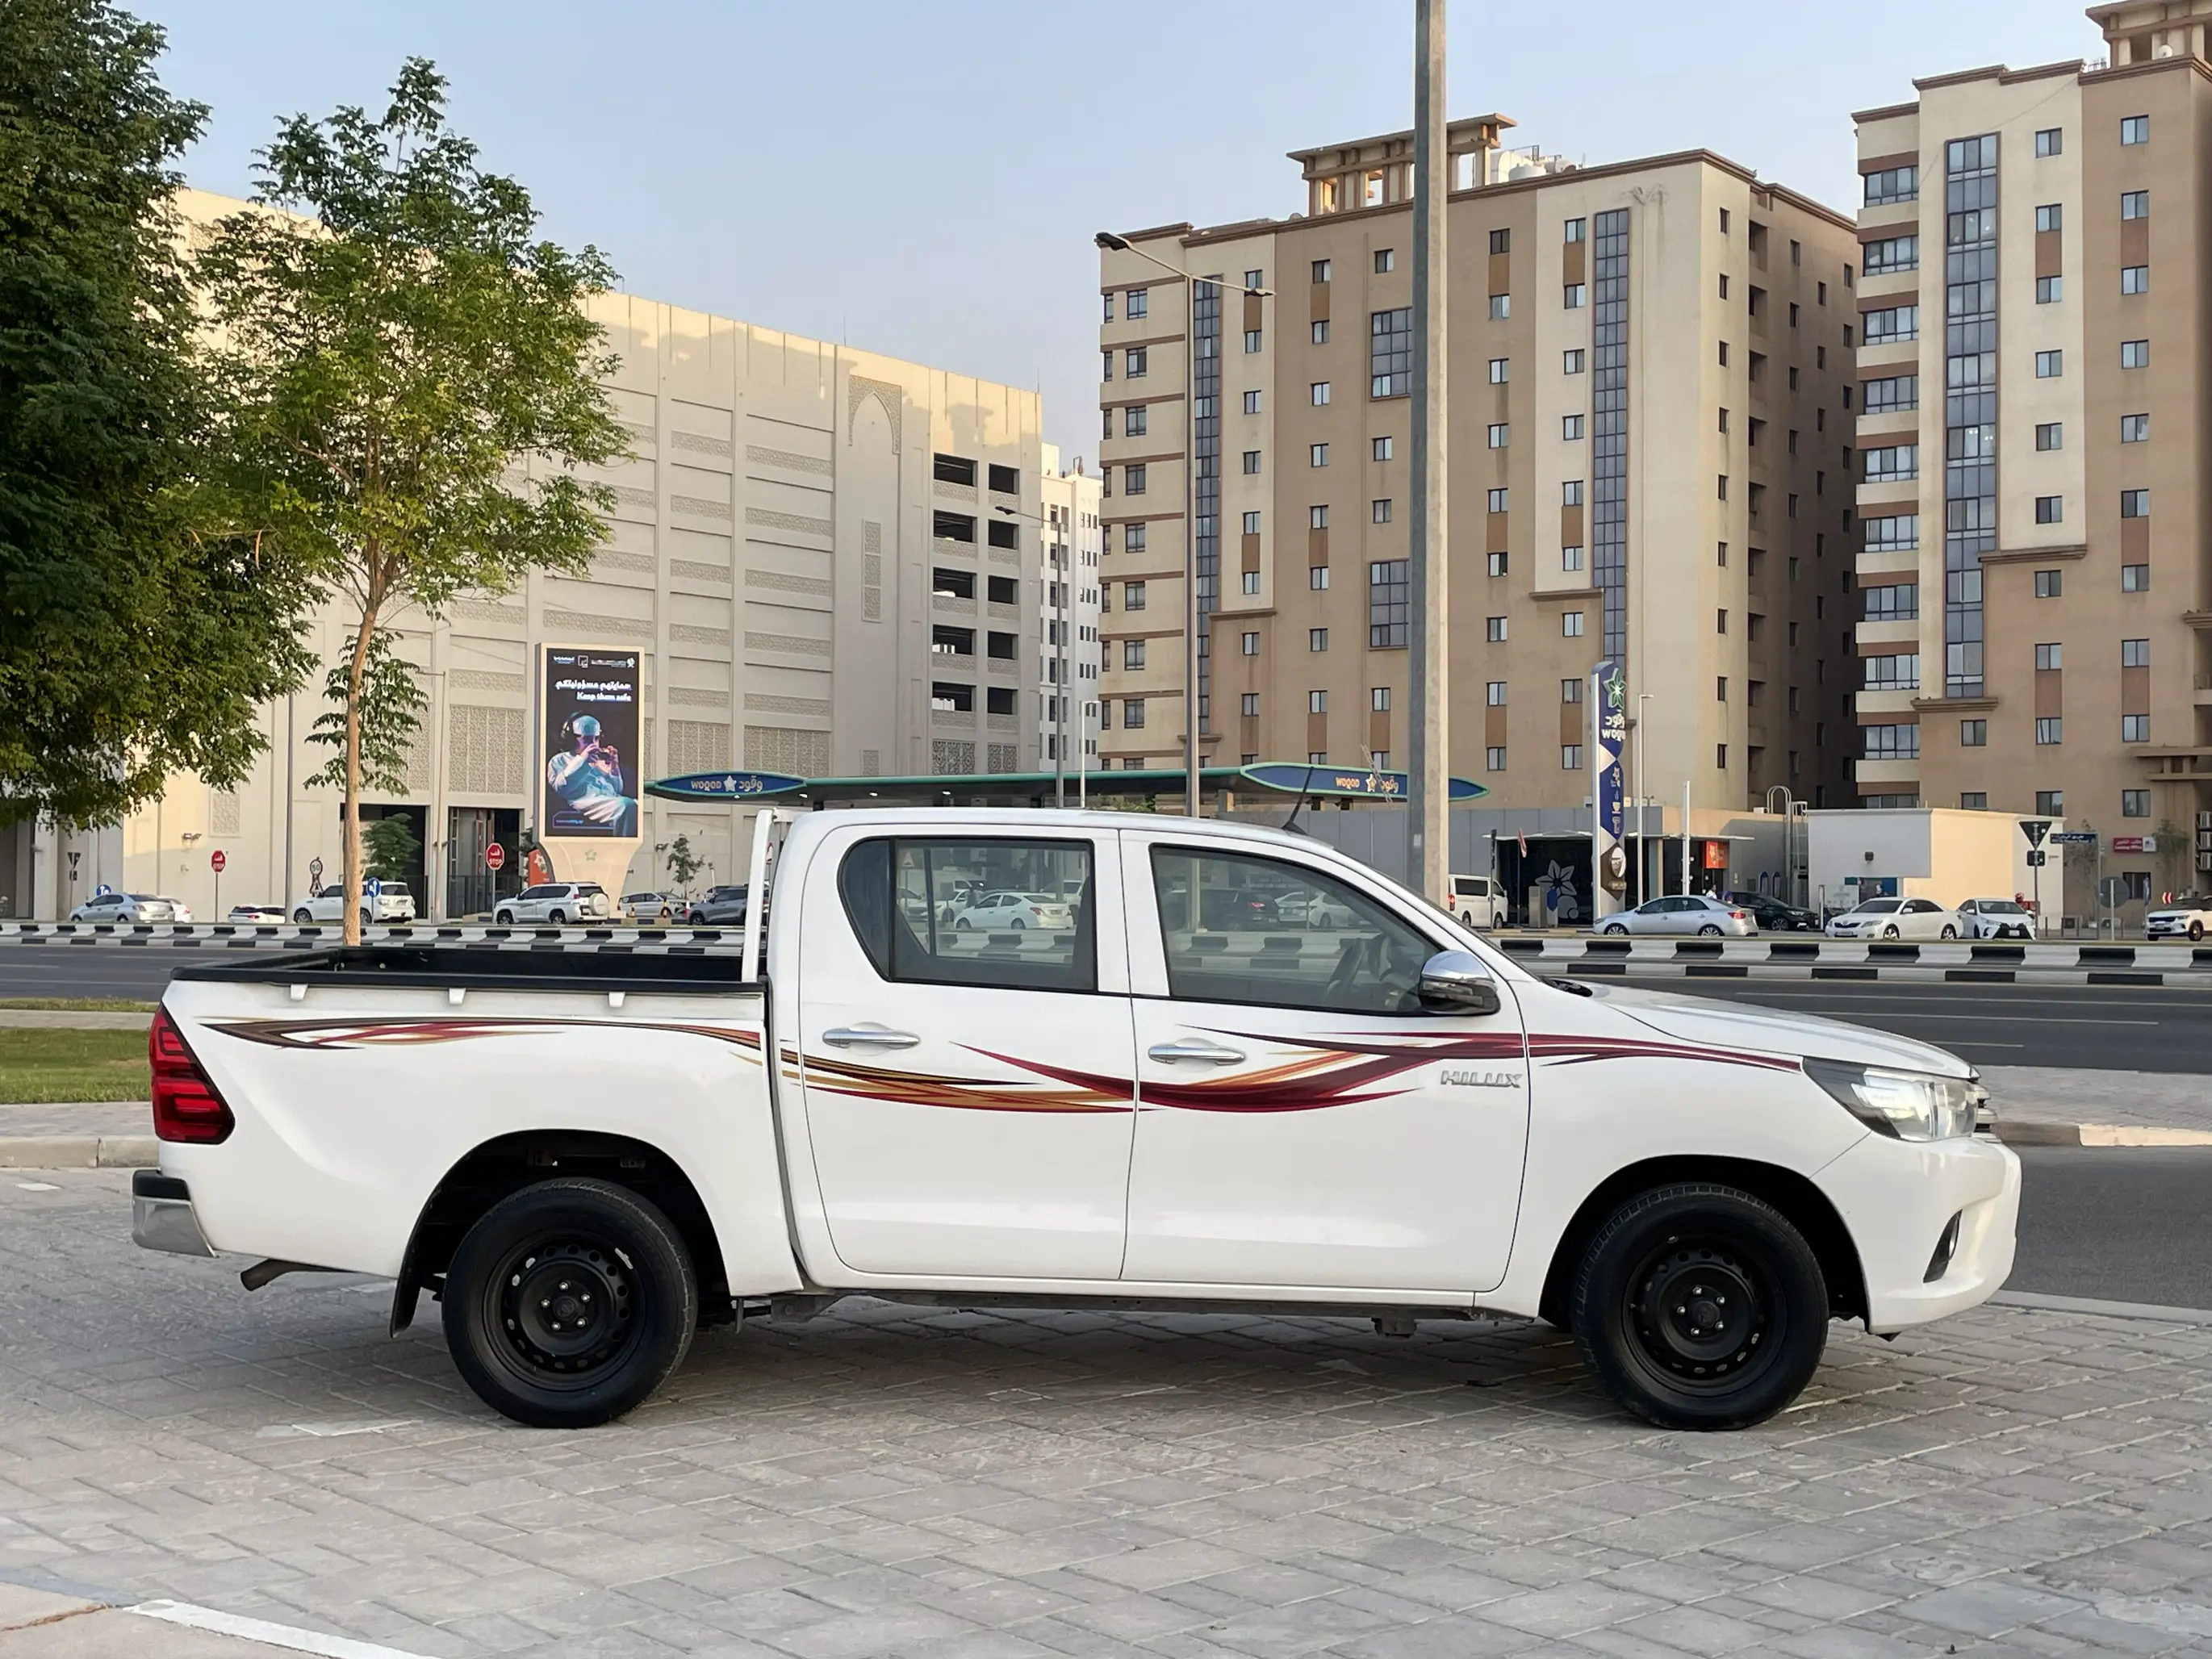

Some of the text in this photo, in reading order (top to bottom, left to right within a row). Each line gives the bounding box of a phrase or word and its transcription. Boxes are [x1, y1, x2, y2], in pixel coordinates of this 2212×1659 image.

[577, 692, 596, 702] Keep
[738, 775, 763, 792] وقود
[488, 858, 502, 866] STOP
[1441, 1070, 1523, 1089] HILUX
